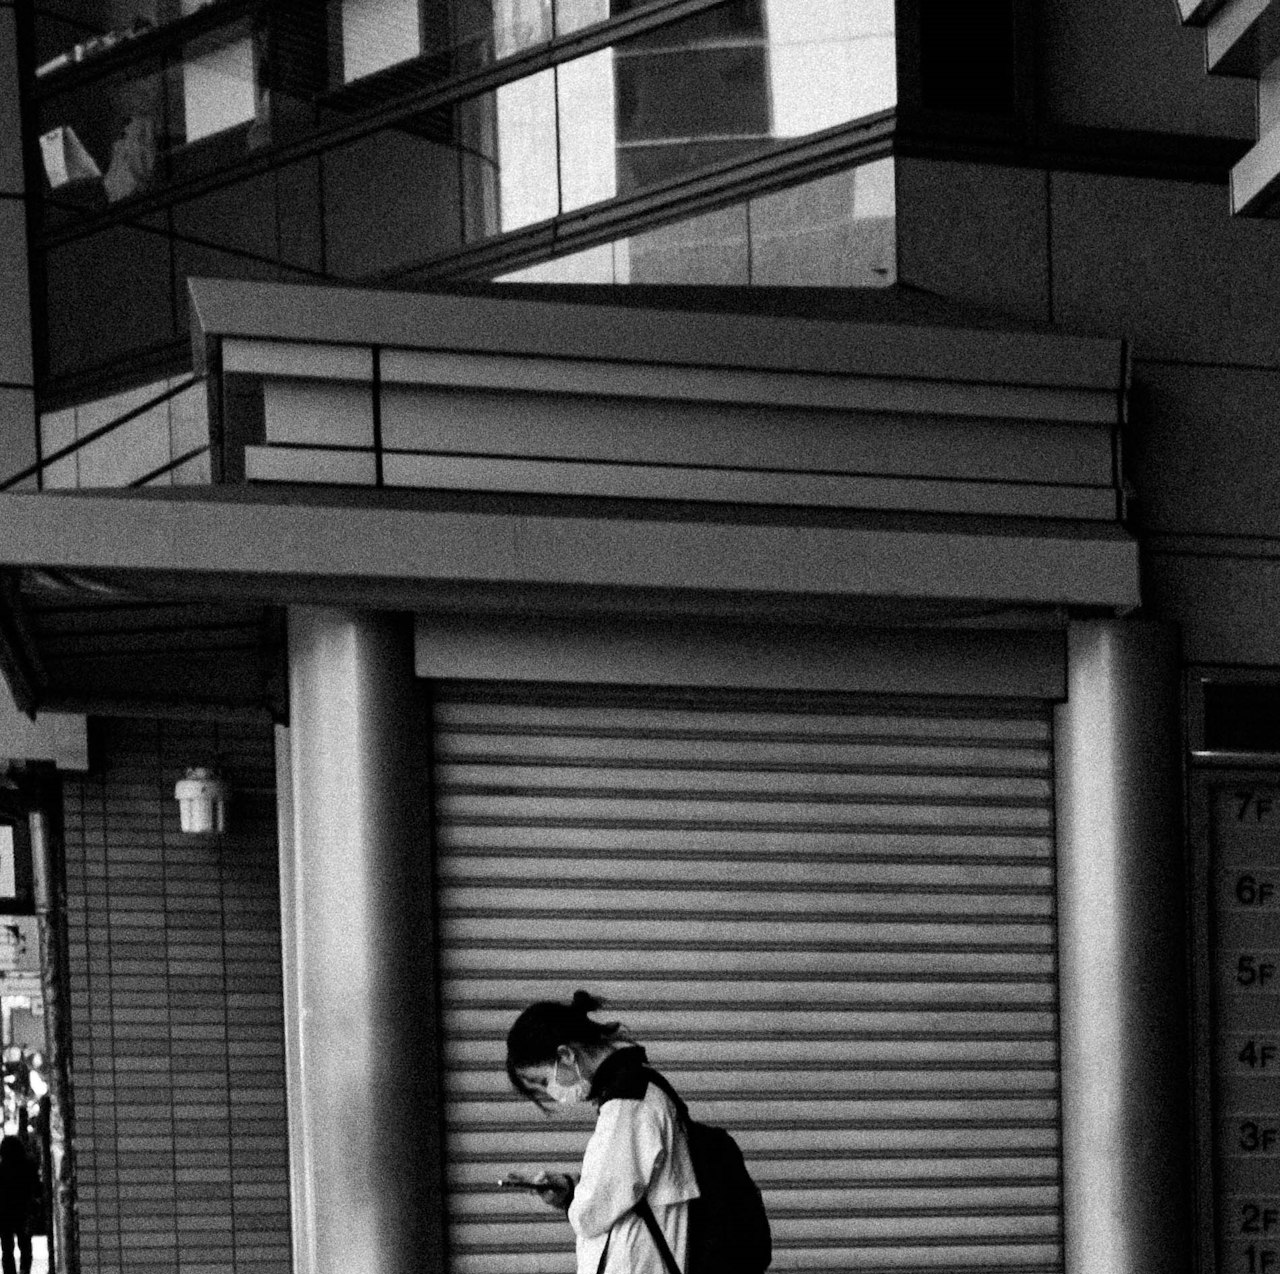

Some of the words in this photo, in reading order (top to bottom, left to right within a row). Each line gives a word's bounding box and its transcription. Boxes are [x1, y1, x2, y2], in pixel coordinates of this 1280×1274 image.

[1235, 791, 1271, 821] 7F
[1236, 876, 1273, 906] 6F
[1237, 956, 1274, 986] 5F
[1238, 1039, 1276, 1068] 4F
[1239, 1122, 1277, 1153] 3F
[1241, 1204, 1279, 1234] 2F
